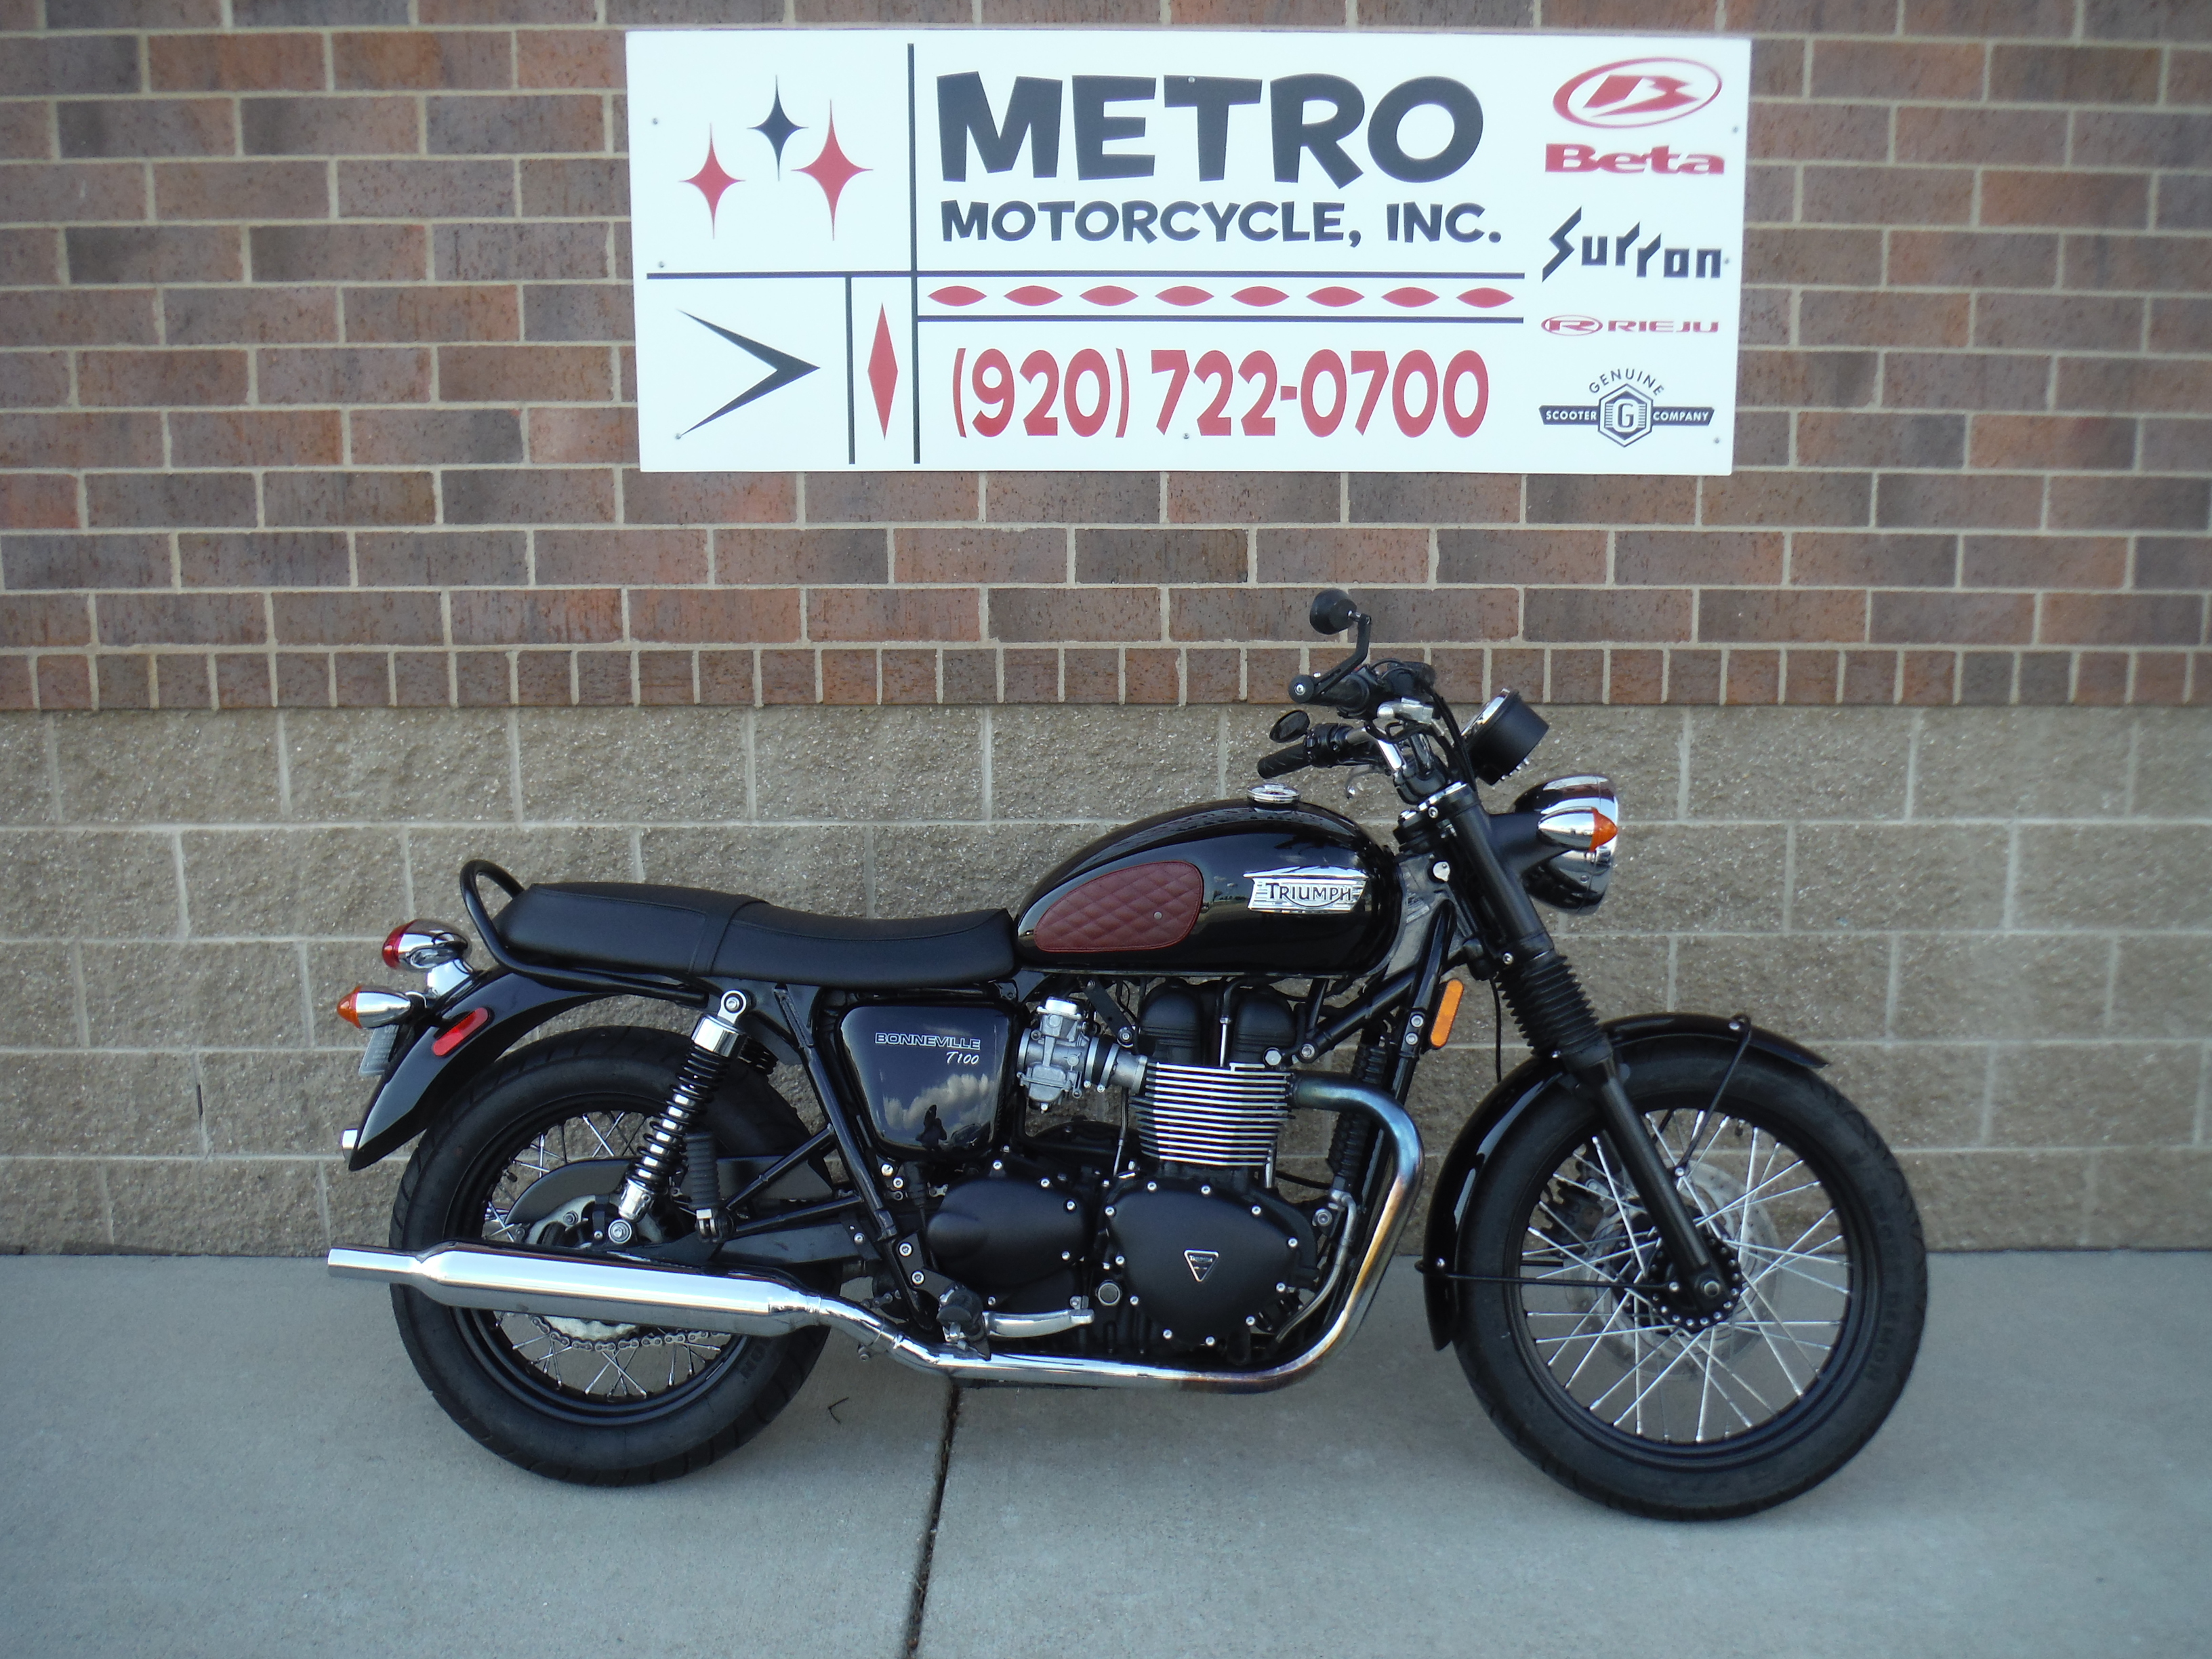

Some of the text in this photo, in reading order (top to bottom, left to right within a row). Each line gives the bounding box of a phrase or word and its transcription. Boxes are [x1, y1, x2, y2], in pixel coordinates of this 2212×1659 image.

[937, 71, 1484, 189] METRO
[1545, 143, 1725, 175] Beta
[941, 200, 1502, 247] MOTORCYCLE, INC.
[1608, 321, 1719, 332] RIEJU
[953, 348, 1489, 438] (920) 722-0700
[1589, 368, 1664, 396] GENUINE
[1546, 409, 1597, 421] SCOOTER
[1617, 403, 1634, 428] G
[1652, 411, 1709, 422] COMPANY
[1265, 882, 1351, 902] TRIUMPH
[875, 1032, 981, 1050] BONNEVILLE
[946, 1051, 980, 1065] T100
